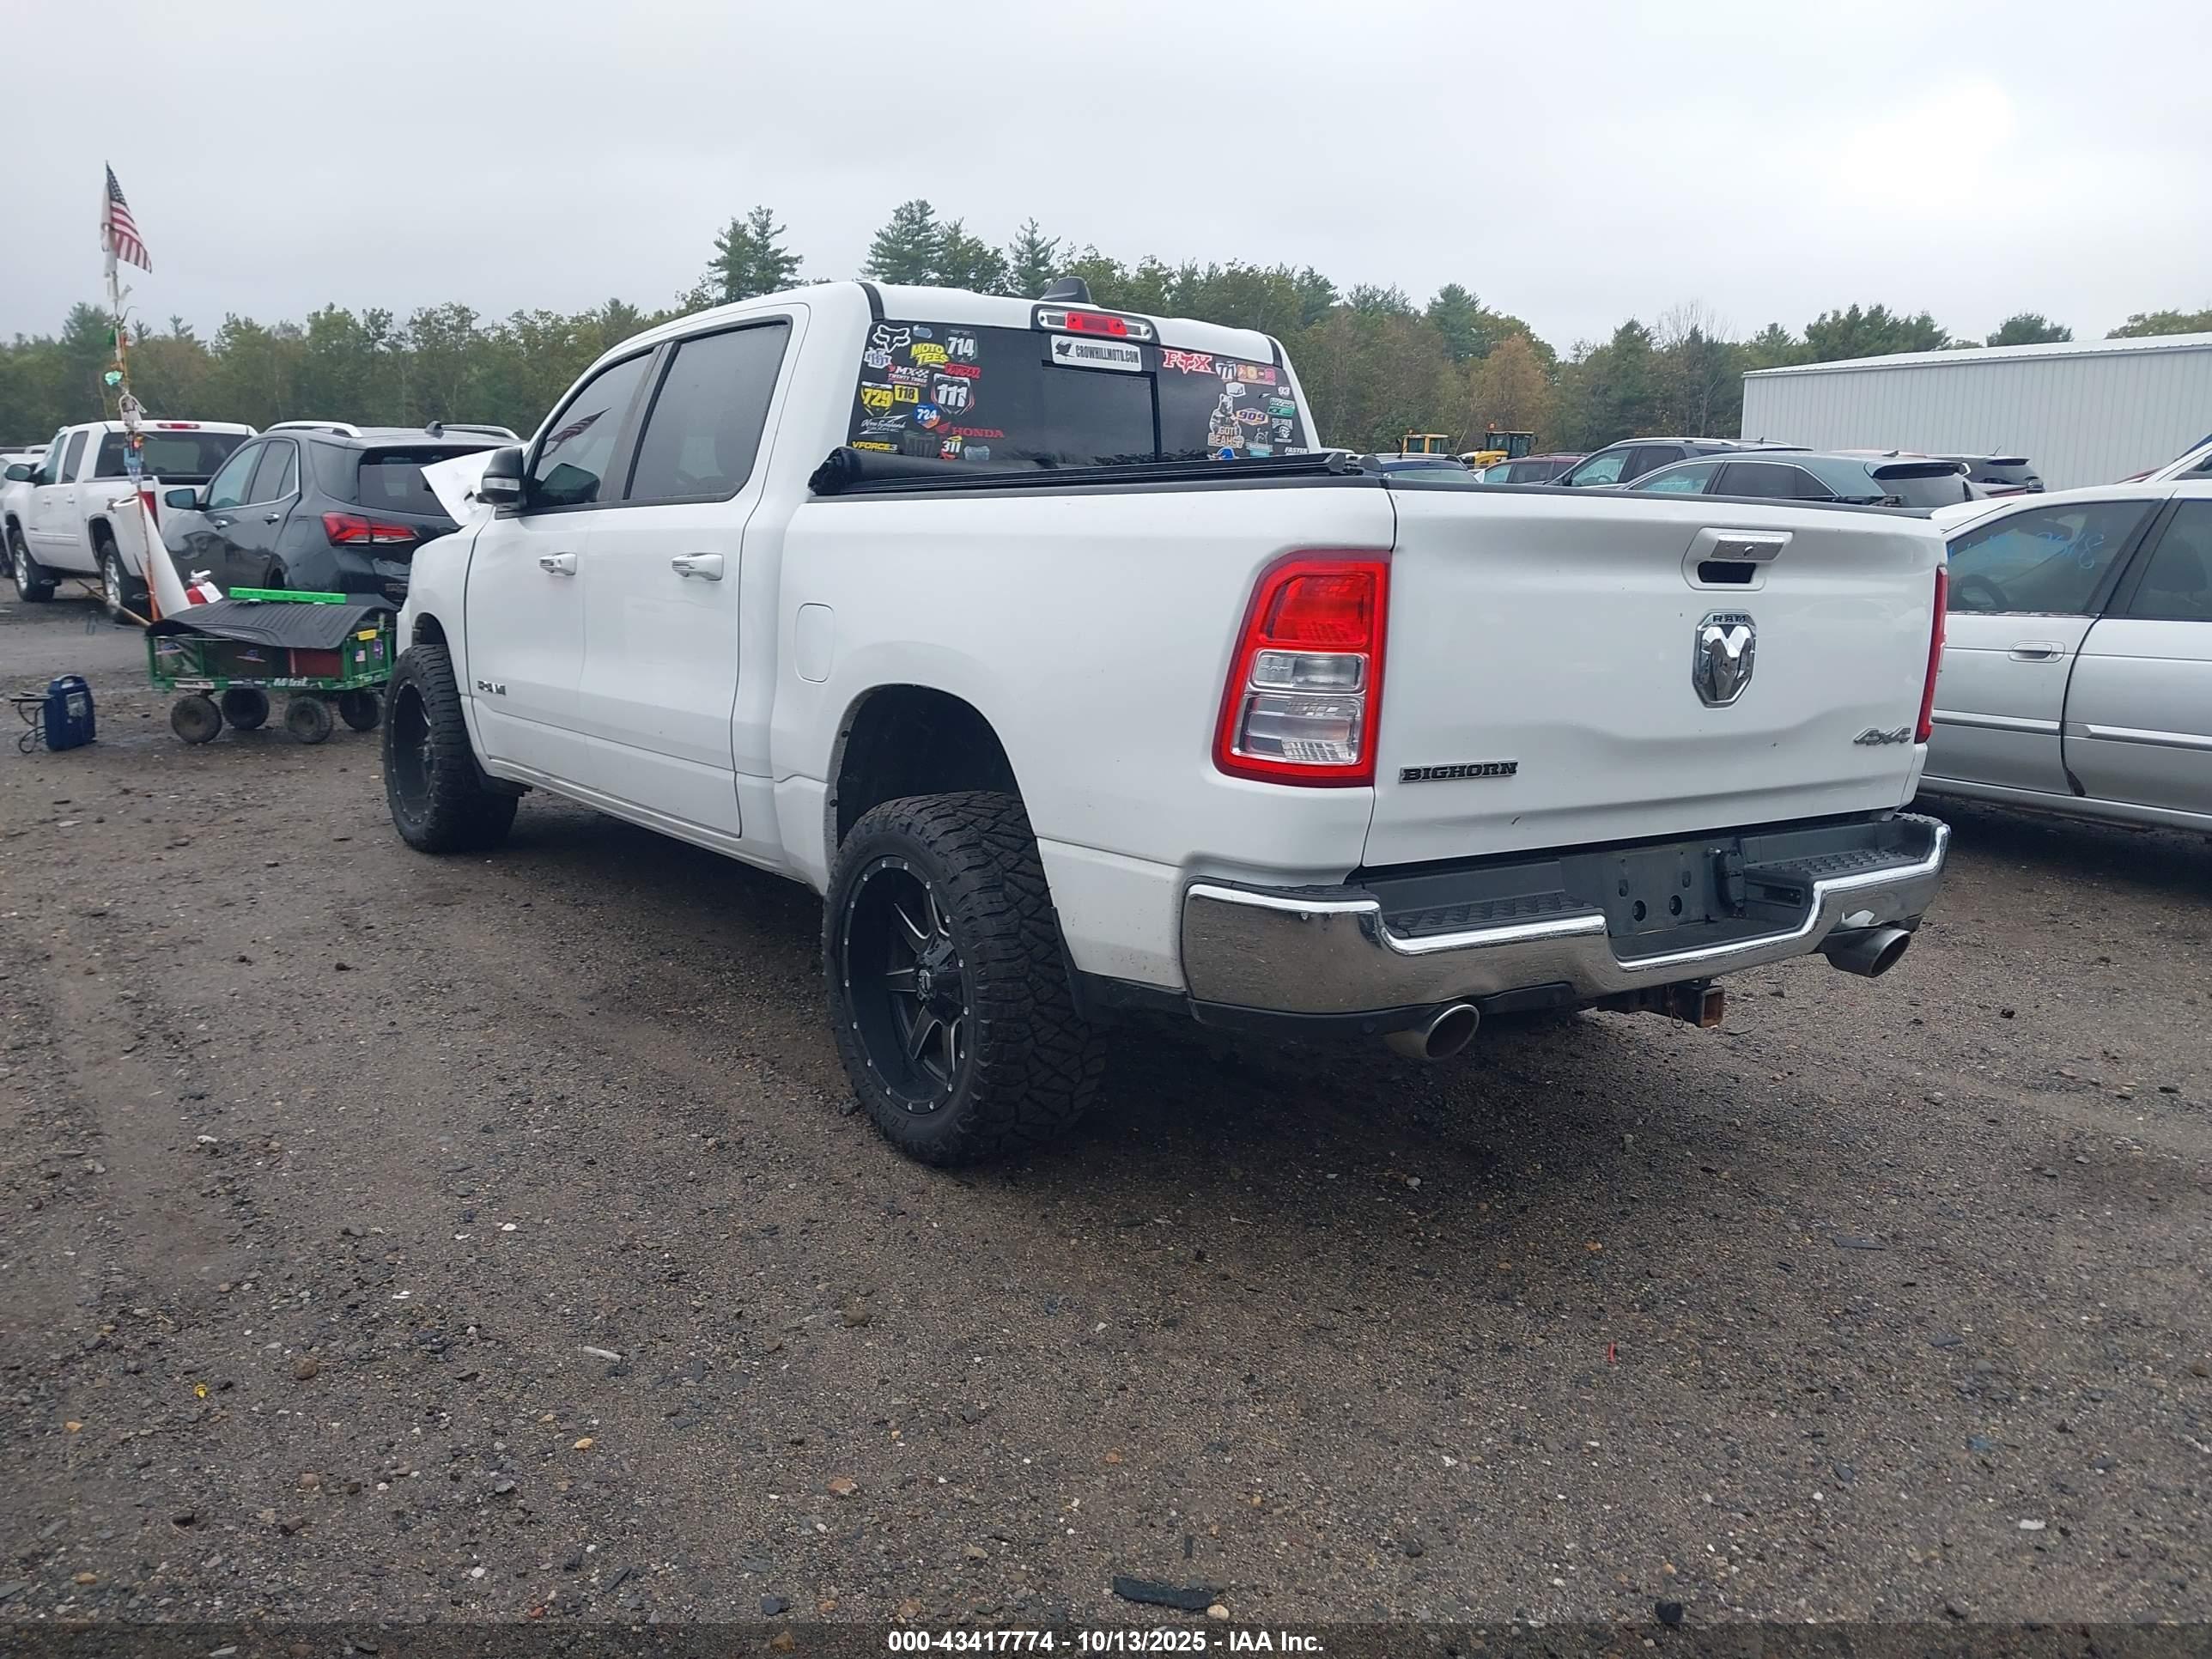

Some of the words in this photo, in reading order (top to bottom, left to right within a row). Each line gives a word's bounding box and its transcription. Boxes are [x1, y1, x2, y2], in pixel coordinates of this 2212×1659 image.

[911, 343, 945, 358] MOTO
[947, 337, 975, 356] 714
[916, 353, 950, 367] TEES
[863, 388, 892, 407] 729
[896, 386, 915, 400] 118
[937, 384, 968, 407] 111
[952, 427, 1004, 437] HONDA
[852, 441, 898, 451] VFORCE3
[941, 441, 962, 453] 311
[1712, 615, 1746, 623] RAM
[1401, 761, 1518, 781] BIGHORN
